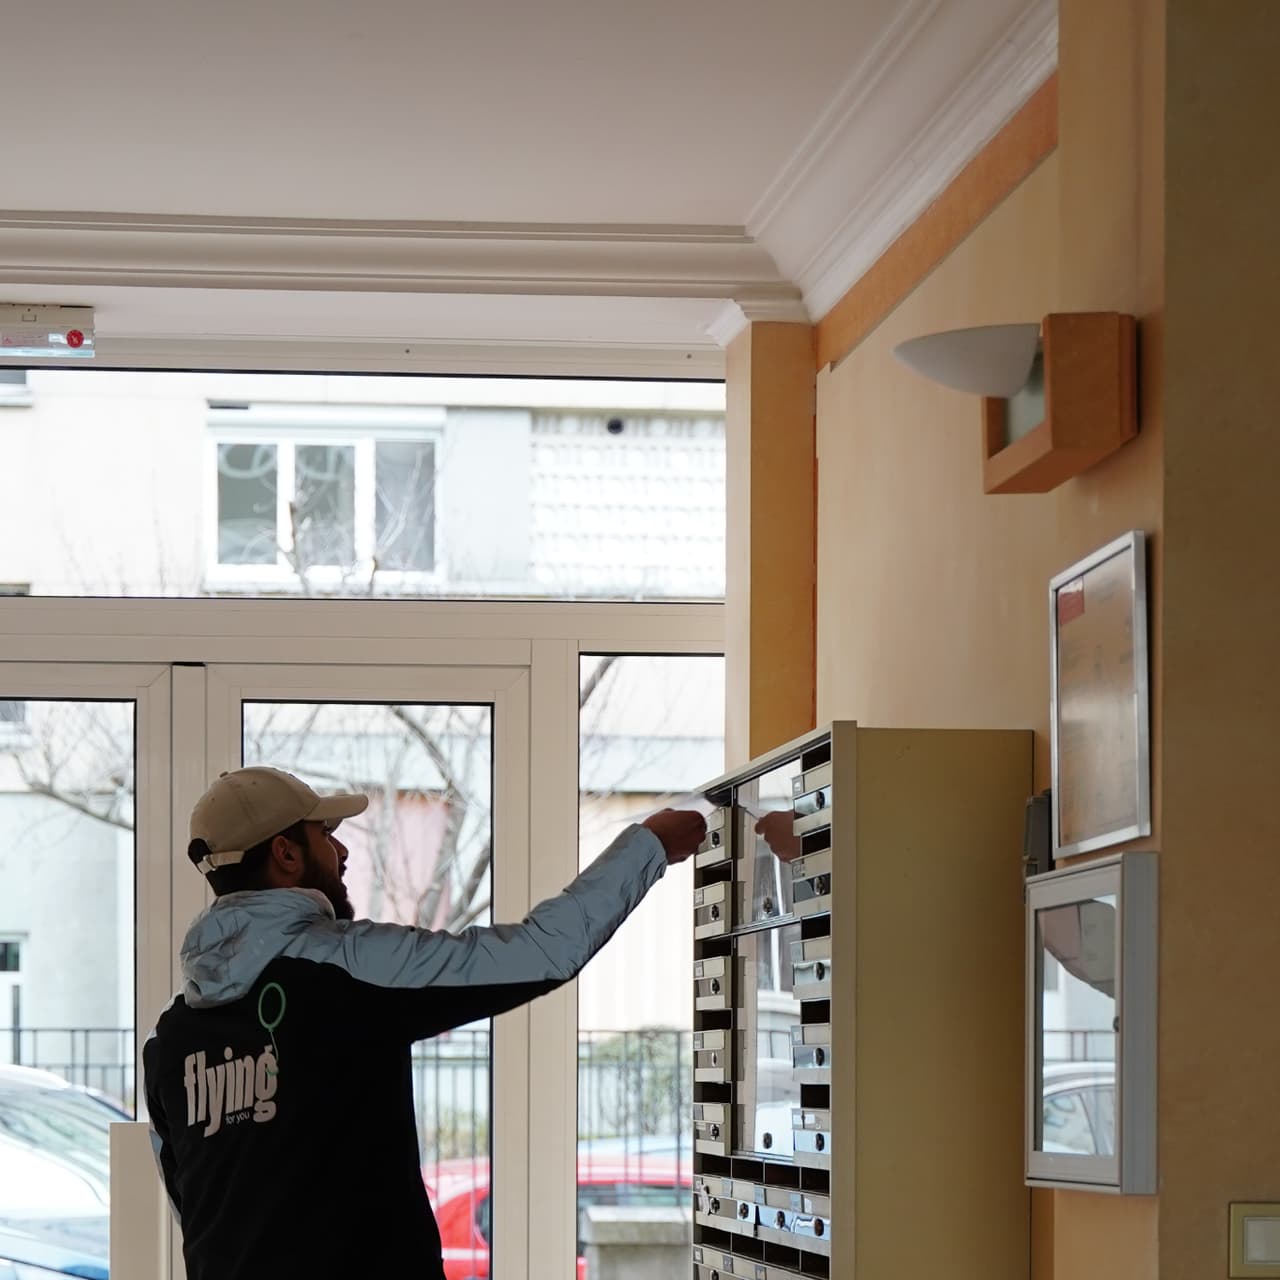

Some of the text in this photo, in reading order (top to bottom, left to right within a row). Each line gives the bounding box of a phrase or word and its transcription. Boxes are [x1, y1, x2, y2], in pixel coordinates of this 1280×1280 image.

[184, 1044, 277, 1137] flying
[224, 1112, 250, 1125] for you
